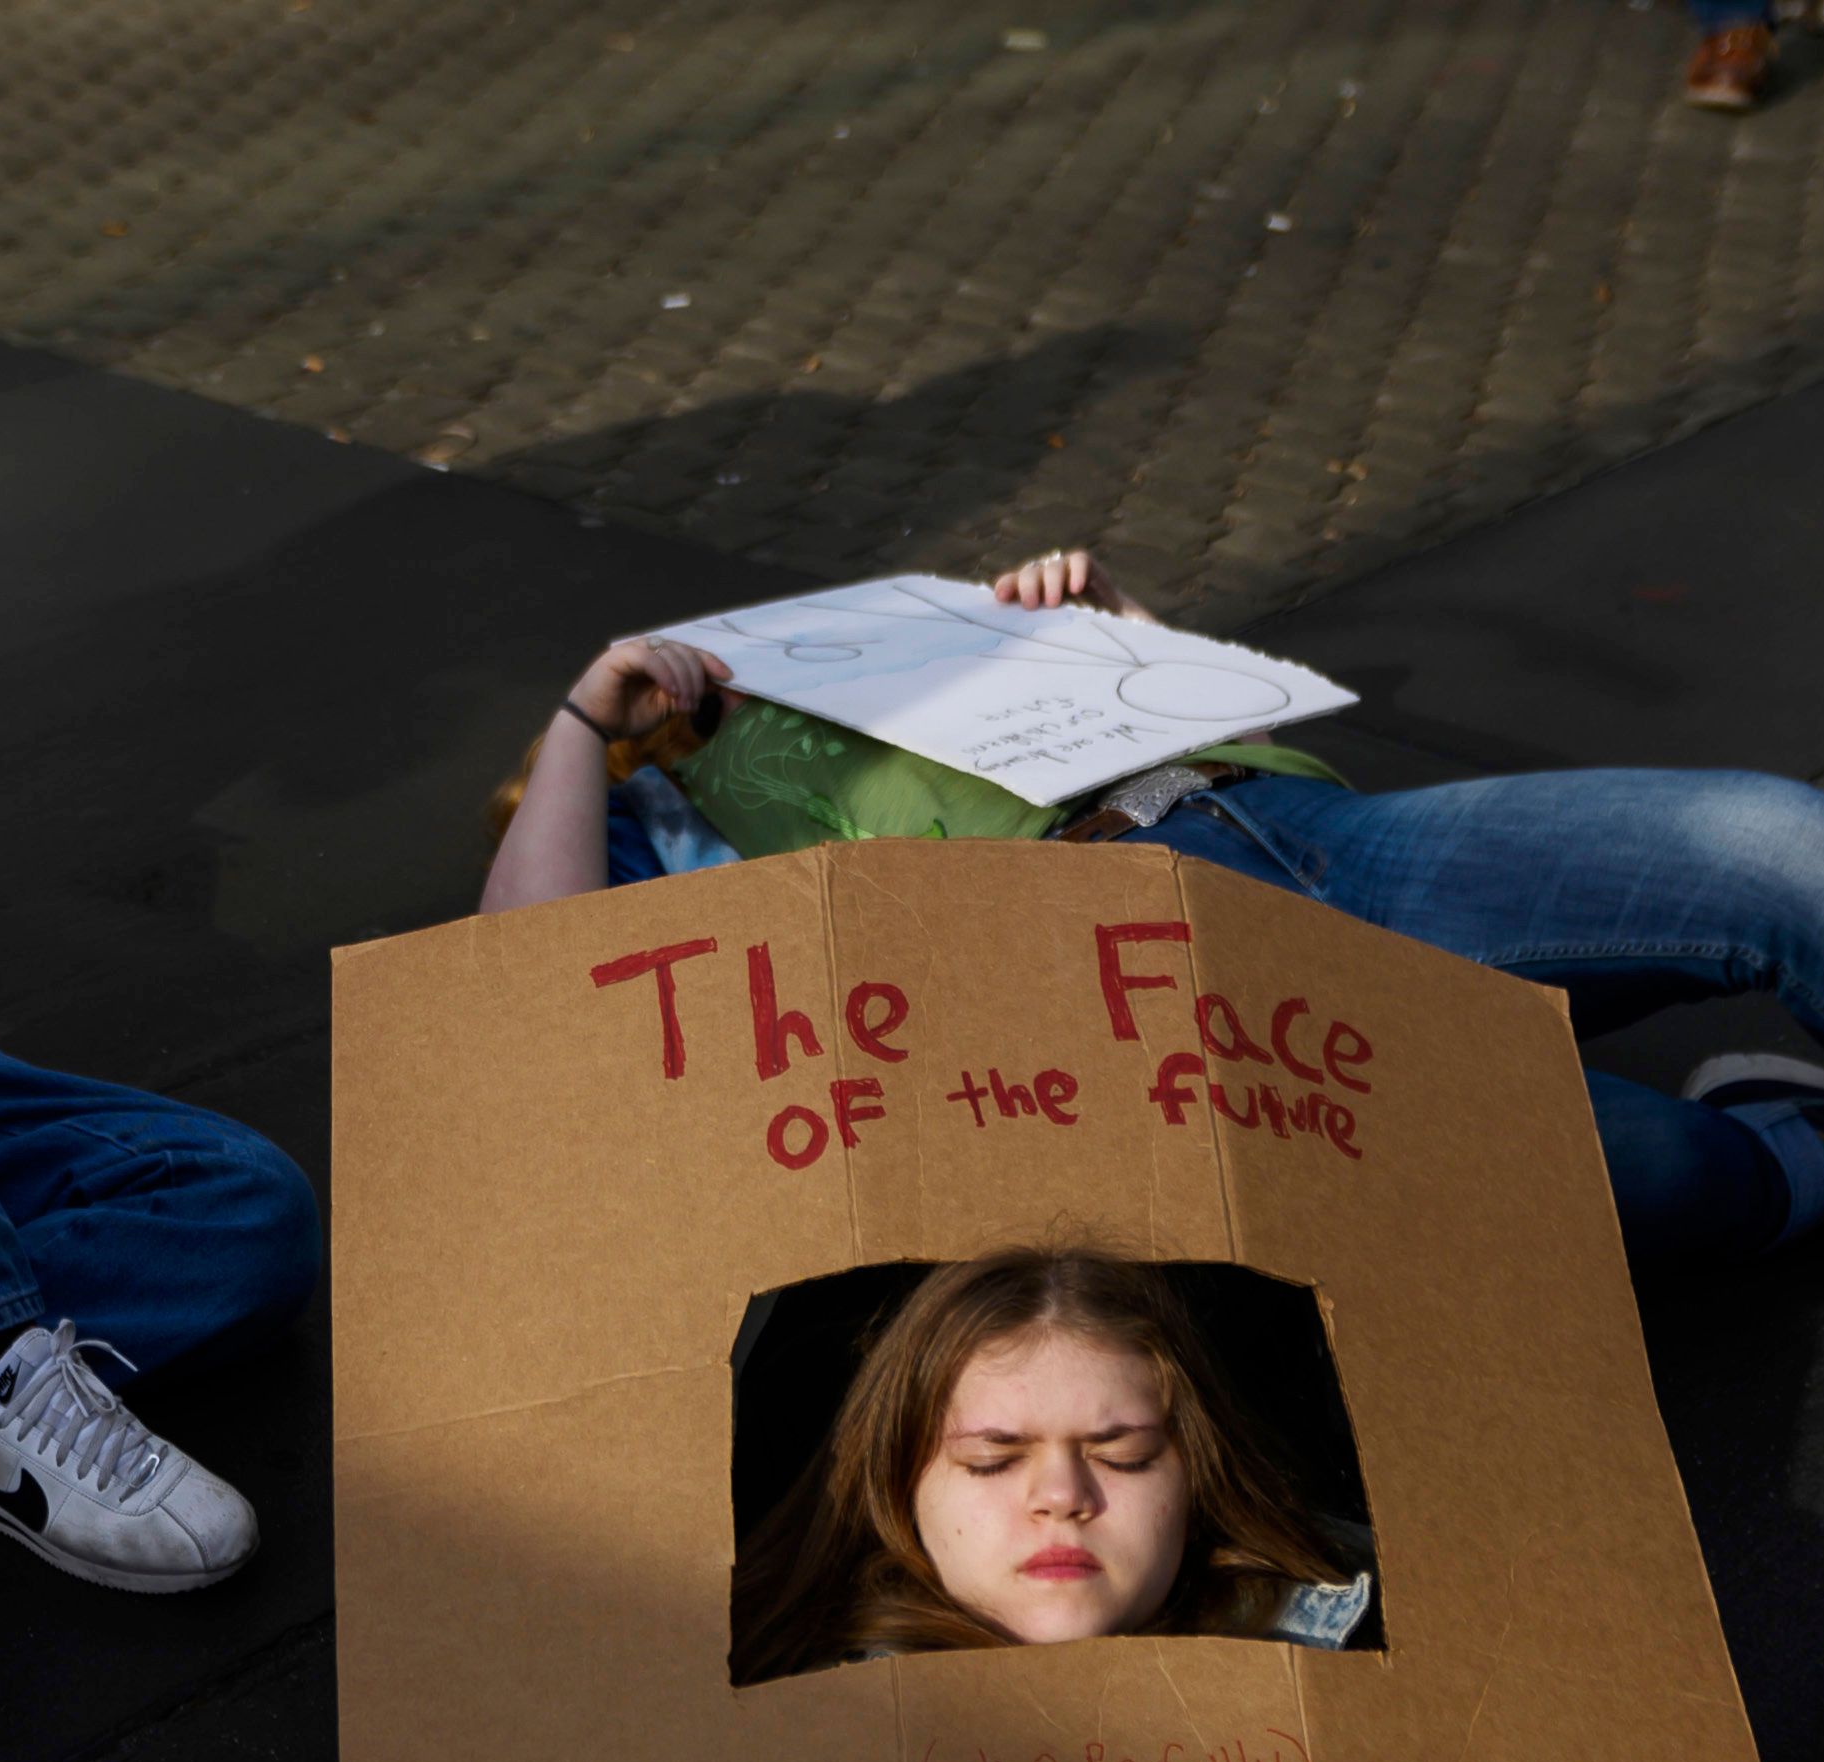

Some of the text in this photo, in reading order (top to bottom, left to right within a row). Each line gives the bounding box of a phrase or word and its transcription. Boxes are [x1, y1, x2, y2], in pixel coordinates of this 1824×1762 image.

[589, 921, 1373, 1094] The Face
[946, 1067, 1080, 1129] the
[1148, 1052, 1364, 1161] future
